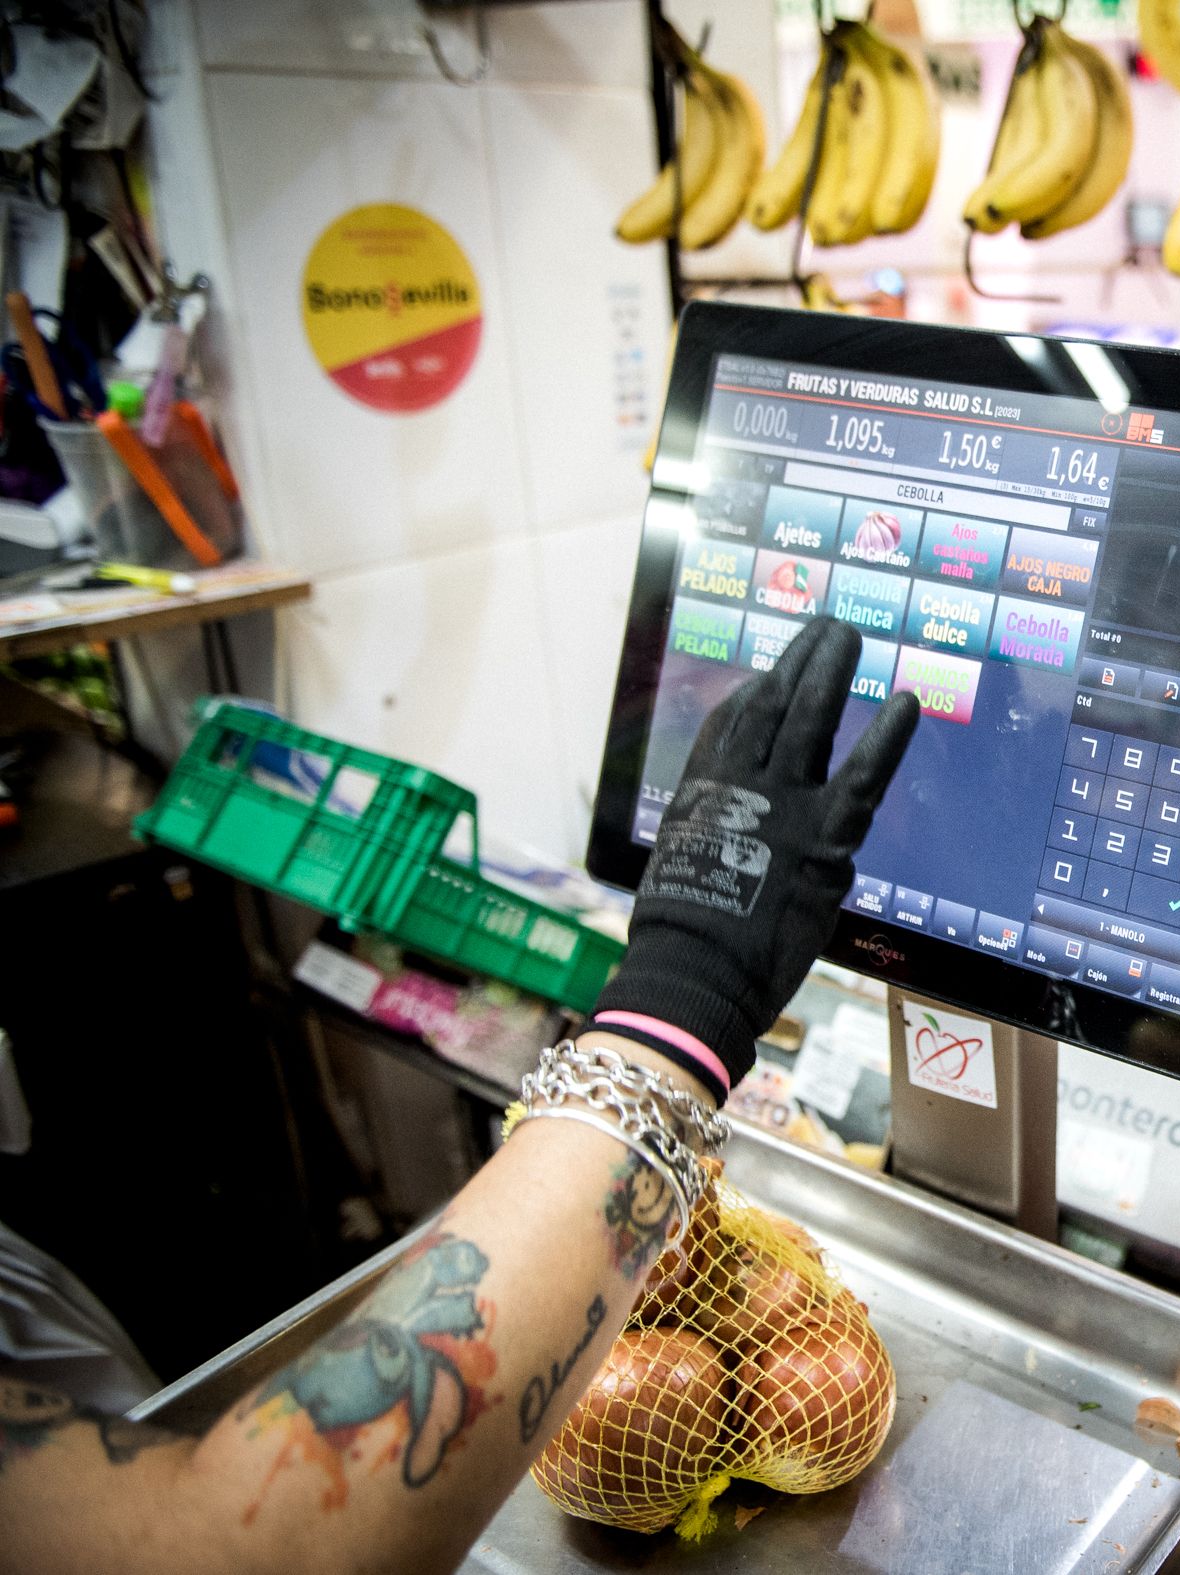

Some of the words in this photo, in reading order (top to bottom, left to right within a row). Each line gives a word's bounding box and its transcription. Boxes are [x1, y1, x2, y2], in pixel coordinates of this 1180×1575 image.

[788, 372, 838, 395] FRUTAS
[839, 379, 850, 397] Y
[851, 381, 919, 406] VERDURAS
[924, 390, 969, 412] SALUD
[971, 397, 994, 416] S.L
[734, 402, 788, 438] 0,000
[826, 415, 885, 453] 1,095
[882, 442, 895, 459] kg
[938, 431, 987, 469] 1,50
[991, 435, 1002, 450] €
[985, 458, 1000, 474] kg
[1046, 446, 1098, 486] 1,64
[1098, 476, 1110, 491] €
[897, 484, 944, 503] CEBOLLA
[773, 520, 822, 549] Ajetes
[951, 523, 978, 541] Ajos
[1083, 516, 1096, 528] FIX
[697, 547, 737, 575] AJOS
[840, 541, 865, 560] Ajos
[867, 547, 911, 568] Castaño
[933, 543, 989, 565] castaños
[940, 561, 974, 580] malla
[1007, 553, 1043, 576] AJOS
[1045, 560, 1092, 584] NEGRO
[679, 567, 747, 599] PELADOS
[836, 572, 900, 604] Cebolla
[1026, 575, 1062, 597] CAJA
[755, 587, 817, 615] CEBOLLA
[834, 594, 893, 630] blanca
[919, 593, 981, 625] Cebolla
[922, 618, 968, 647] dulce
[1006, 612, 1069, 643] Cebolla
[1091, 629, 1111, 642] Total
[674, 632, 729, 661] PELADA
[754, 636, 785, 657] FRES
[999, 635, 1064, 668] Morada
[751, 653, 775, 672] GRA
[850, 676, 886, 700] LOTA
[905, 660, 971, 694] CHINOS
[913, 685, 956, 714] AJOS
[1076, 694, 1092, 708] Ctd
[1081, 736, 1098, 758] 7
[1123, 747, 1143, 769] 8
[1071, 778, 1089, 800] 4
[1115, 789, 1134, 811] 5
[1160, 801, 1180, 823] 6
[1061, 819, 1078, 841] 1
[1106, 831, 1125, 854] 2
[1152, 843, 1171, 866] 3
[856, 898, 883, 914] PEDIDOS
[896, 911, 923, 927] ARTHUR
[978, 934, 1008, 952] Opciones
[1099, 921, 1105, 932] 1
[1110, 925, 1146, 944] MANOLO
[1026, 950, 1046, 963] Modo
[1087, 968, 1108, 983] Cajón
